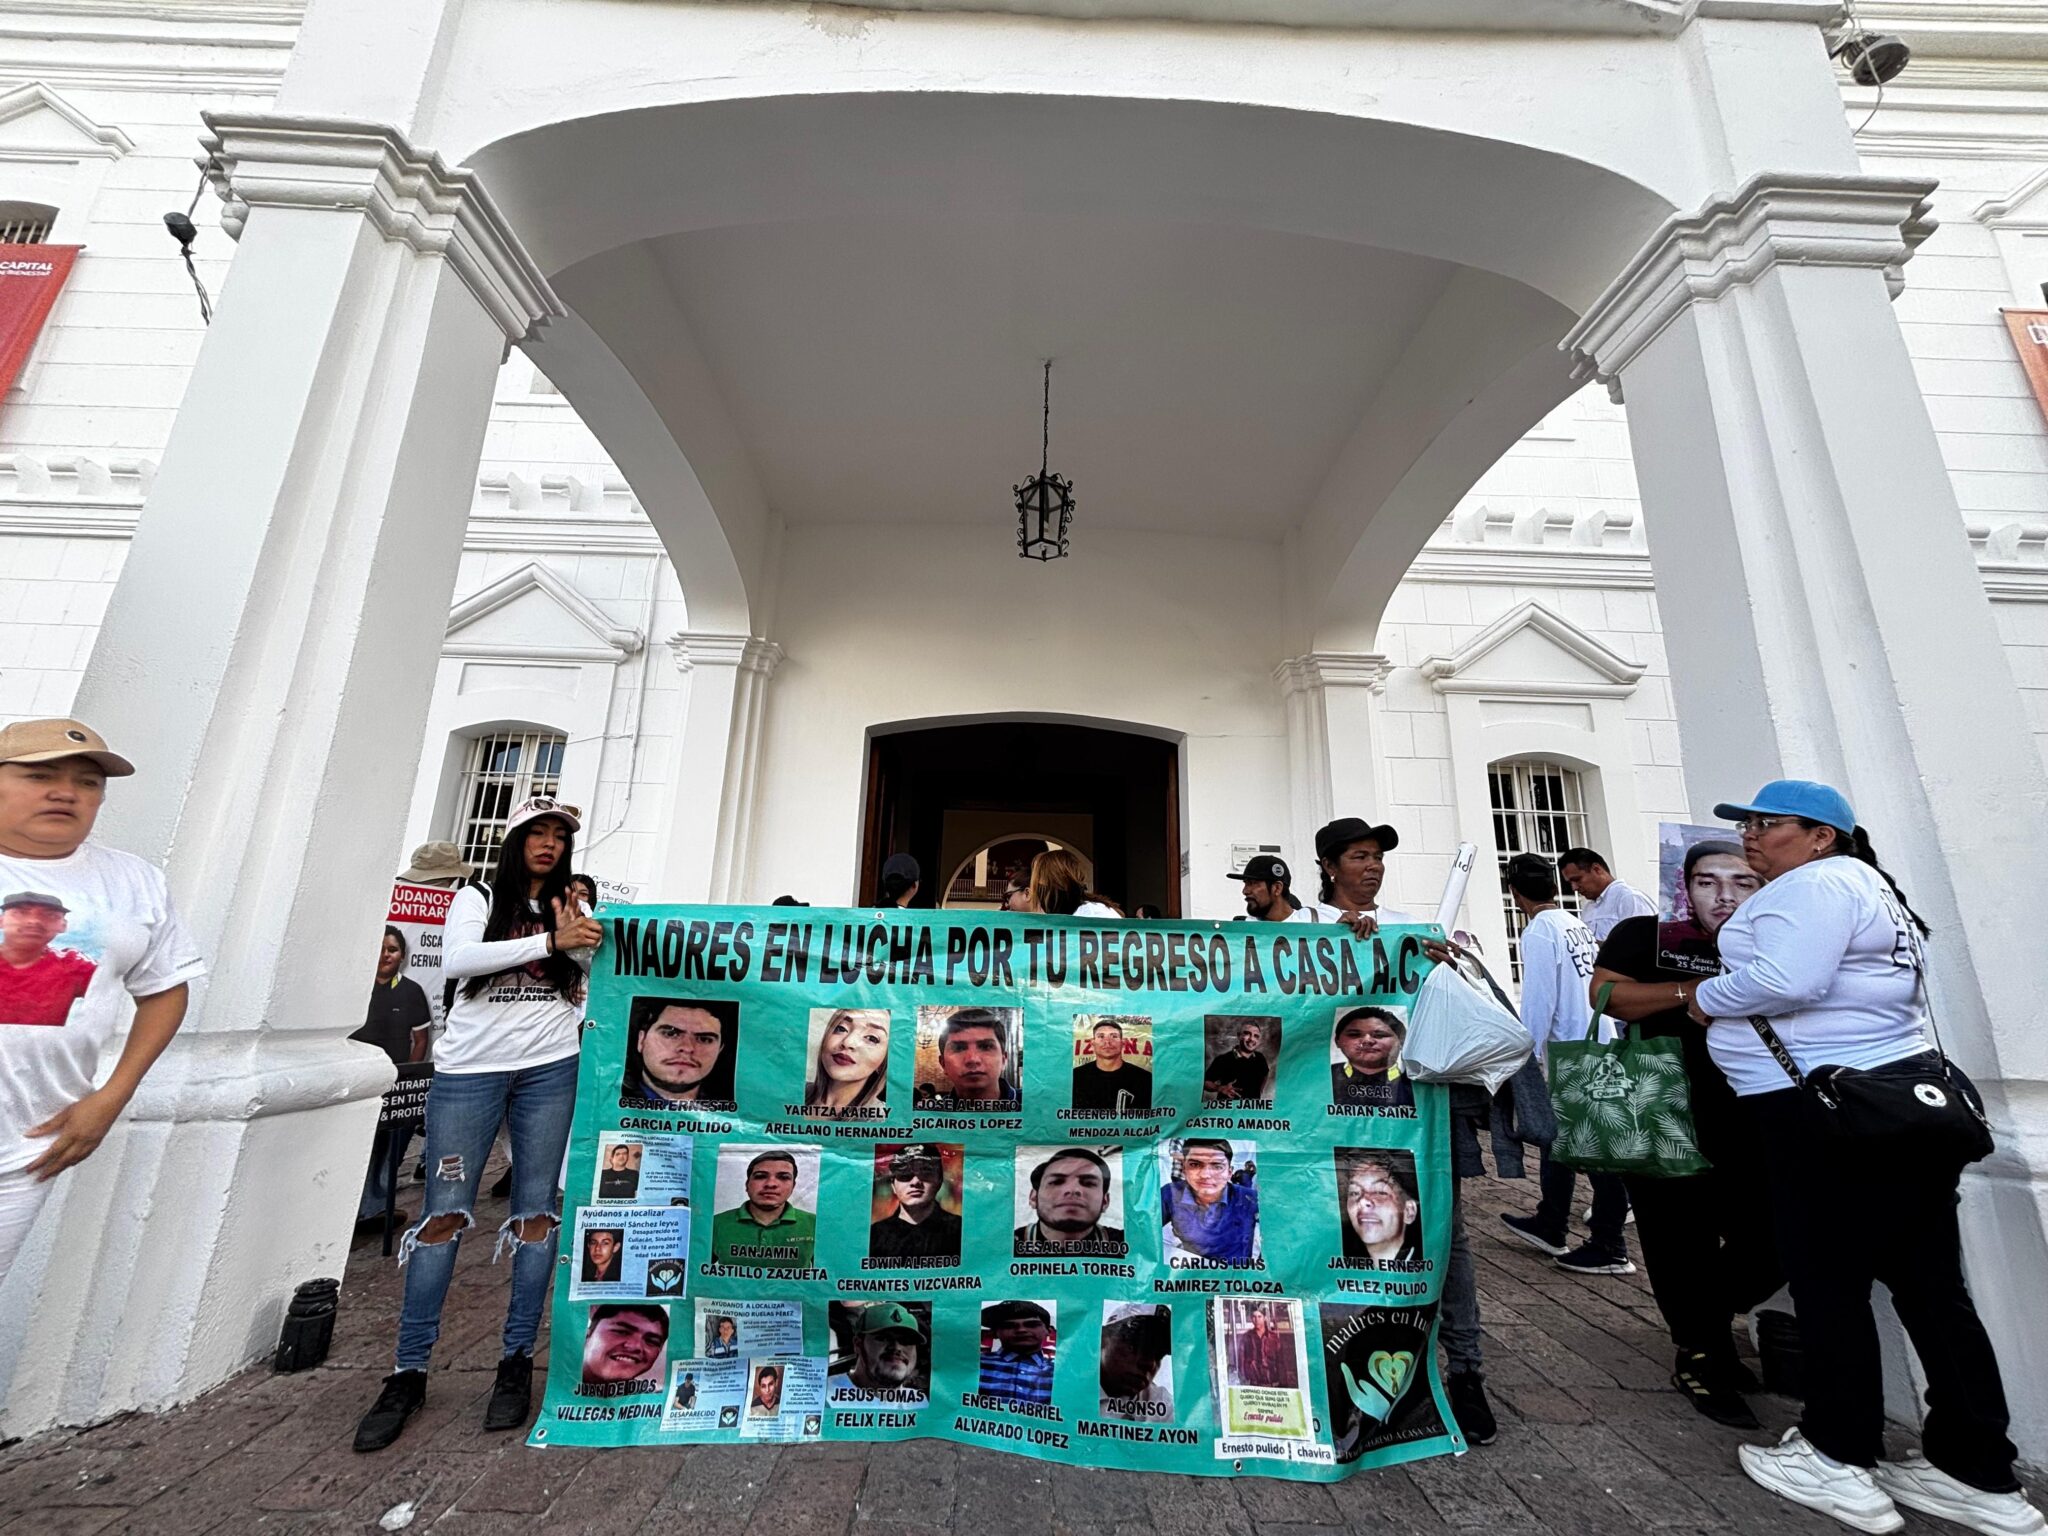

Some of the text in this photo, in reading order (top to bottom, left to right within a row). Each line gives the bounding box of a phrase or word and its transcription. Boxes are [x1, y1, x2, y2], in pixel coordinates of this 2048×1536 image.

[0, 261, 53, 270] CAPITAL
[614, 917, 752, 982] MADRES
[760, 921, 810, 984] EN
[820, 923, 934, 986] LUCHA
[945, 926, 1014, 987] POR
[1023, 928, 1068, 989] TU
[1079, 930, 1231, 993] REGRESO
[1243, 935, 1268, 994] A
[1272, 936, 1365, 996] CASA
[1677, 960, 1688, 968] 25
[488, 995, 516, 1003] VEGA
[1770, 1038, 1793, 1072] LOLA
[1348, 1084, 1392, 1099] OSCAR
[391, 1095, 405, 1106] EN
[407, 1093, 416, 1104] TI
[618, 1097, 738, 1113] CESAR ERNESTO
[916, 1098, 1019, 1113] JOSE ALBERTO
[1204, 1098, 1273, 1111] JOSE JAIME
[784, 1103, 892, 1120] YARITZA KARELY
[1056, 1106, 1176, 1120] CRECENCIO HUMBERTO
[1327, 1104, 1418, 1119] DARIAN SAINZ
[619, 1116, 733, 1134] GARCIA PULIDO
[765, 1122, 914, 1139] ARELLANO HERNANDEZ
[912, 1116, 1023, 1130] SICAIROS LOPEZ
[1186, 1117, 1291, 1132] CASTRO AMADOR
[1069, 1125, 1160, 1138] MENDOZA ALCALA
[582, 1209, 622, 1219] Ayúdanos
[631, 1209, 665, 1217] localizar
[659, 1220, 679, 1228] leyva
[730, 1245, 799, 1259] BANJAMIN
[1015, 1240, 1130, 1255] CESAR EDUARDO
[860, 1255, 961, 1270] EDWIN ALFREDO
[1010, 1262, 1136, 1278] ORPINELA TORRES
[1169, 1256, 1266, 1271] CARLOS LUIS
[1327, 1256, 1434, 1273] JAVIER ERNESTO
[700, 1263, 763, 1280] CASTILLO
[766, 1266, 828, 1281] ZAZUETA
[837, 1277, 910, 1292] CERVANTES
[1154, 1279, 1284, 1294] RAMIREZ TOLOZA
[1336, 1279, 1428, 1296] VELEZ PULIDO
[1325, 1311, 1385, 1354] madres
[1391, 1311, 1409, 1324] en
[574, 1379, 657, 1397] JUAN DE DIOS
[831, 1387, 875, 1402] JESUS
[877, 1388, 925, 1403] TOMAS
[557, 1403, 662, 1422] VILLEGAS MEDINA
[670, 1410, 716, 1418] DESAPARECIDO
[962, 1392, 1064, 1422] ENGEL GABRIEL
[1107, 1398, 1167, 1417] ALONSO
[835, 1413, 917, 1427] FELIX FELIX
[954, 1416, 1069, 1449] ALVARADO LOPEZ
[1077, 1420, 1198, 1444] MARTINEZ AYON
[1222, 1443, 1254, 1453] Ernesto
[1256, 1443, 1285, 1455] pulido
[1297, 1446, 1331, 1460] chavira
